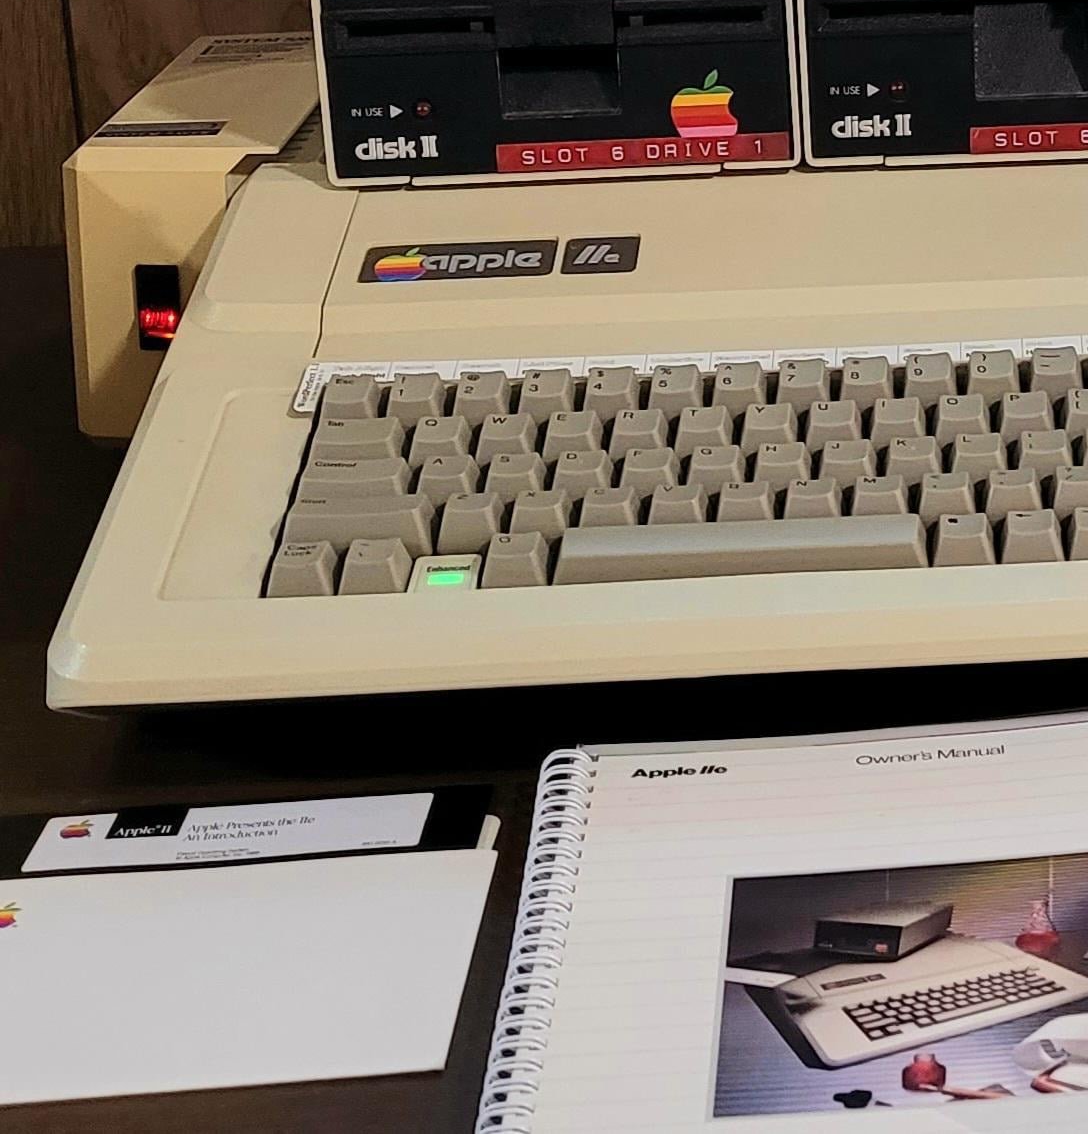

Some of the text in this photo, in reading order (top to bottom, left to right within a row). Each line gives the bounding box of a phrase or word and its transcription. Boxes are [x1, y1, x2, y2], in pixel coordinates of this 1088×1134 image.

[829, 85, 861, 96] IN USE
[351, 106, 384, 117] IN USE
[831, 114, 891, 138] disk
[994, 129, 1058, 147] SLOT
[354, 136, 417, 161] disk
[521, 139, 764, 166] SLOT 6 DRIVE 1
[423, 249, 542, 273] apple
[787, 374, 796, 383] 7
[850, 372, 860, 380] 8
[658, 380, 668, 388] 5
[722, 377, 732, 386] 6
[463, 386, 475, 395] 2
[528, 384, 539, 393] 3
[593, 382, 603, 391] 4
[1009, 394, 1020, 402] P
[754, 406, 766, 414] Y
[817, 403, 829, 411] U
[622, 411, 634, 420] R
[425, 419, 437, 428] Q
[492, 417, 507, 425] W
[701, 448, 713, 456] G
[765, 445, 777, 453] H
[500, 455, 511, 463] S
[566, 452, 577, 461] D
[426, 565, 471, 574] Enhanced
[856, 745, 1005, 767] Owner's Manual
[631, 765, 696, 779] Apple
[161, 824, 173, 834] II
[188, 823, 224, 834] Apple
[226, 819, 275, 831] Presents
[277, 817, 297, 827] the
[182, 828, 279, 842] An Introduction
